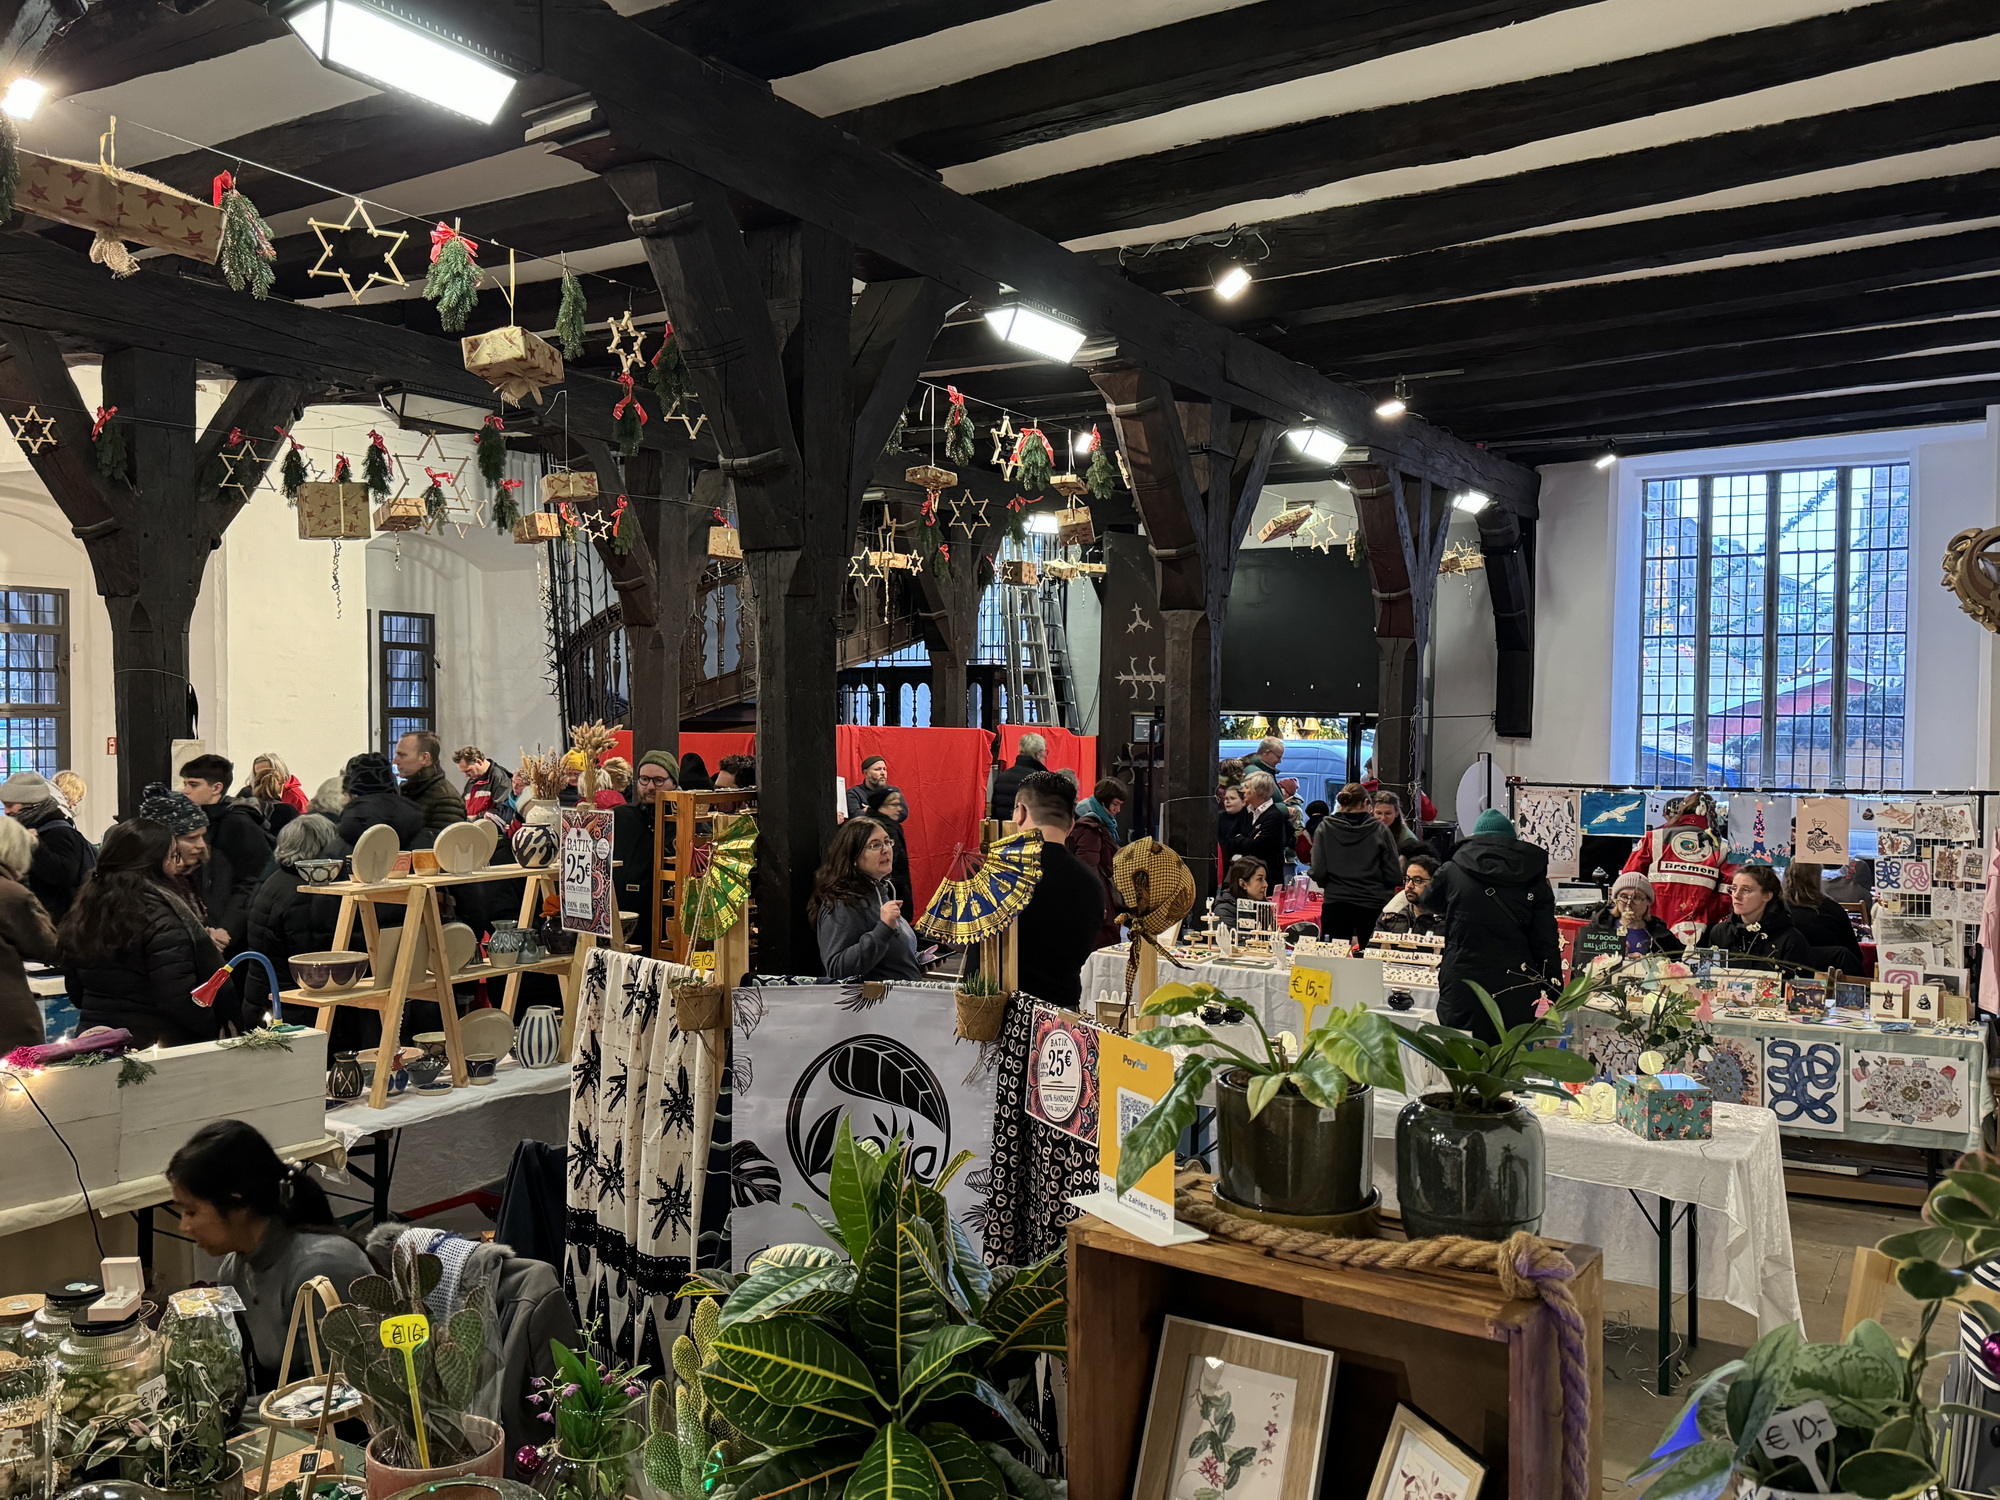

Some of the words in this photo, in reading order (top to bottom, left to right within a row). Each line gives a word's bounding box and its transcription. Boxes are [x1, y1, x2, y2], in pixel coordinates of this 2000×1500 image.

[566, 838, 591, 852] BATIK
[566, 853, 591, 885] 25€
[1664, 862, 1716, 876] Bremen
[1050, 1038, 1068, 1047] BATIK
[1048, 1049, 1072, 1077] 25€
[1122, 1054, 1148, 1071] PayPal
[1128, 1194, 1149, 1211] Zahlen.
[1149, 1204, 1168, 1221] Fertig.
